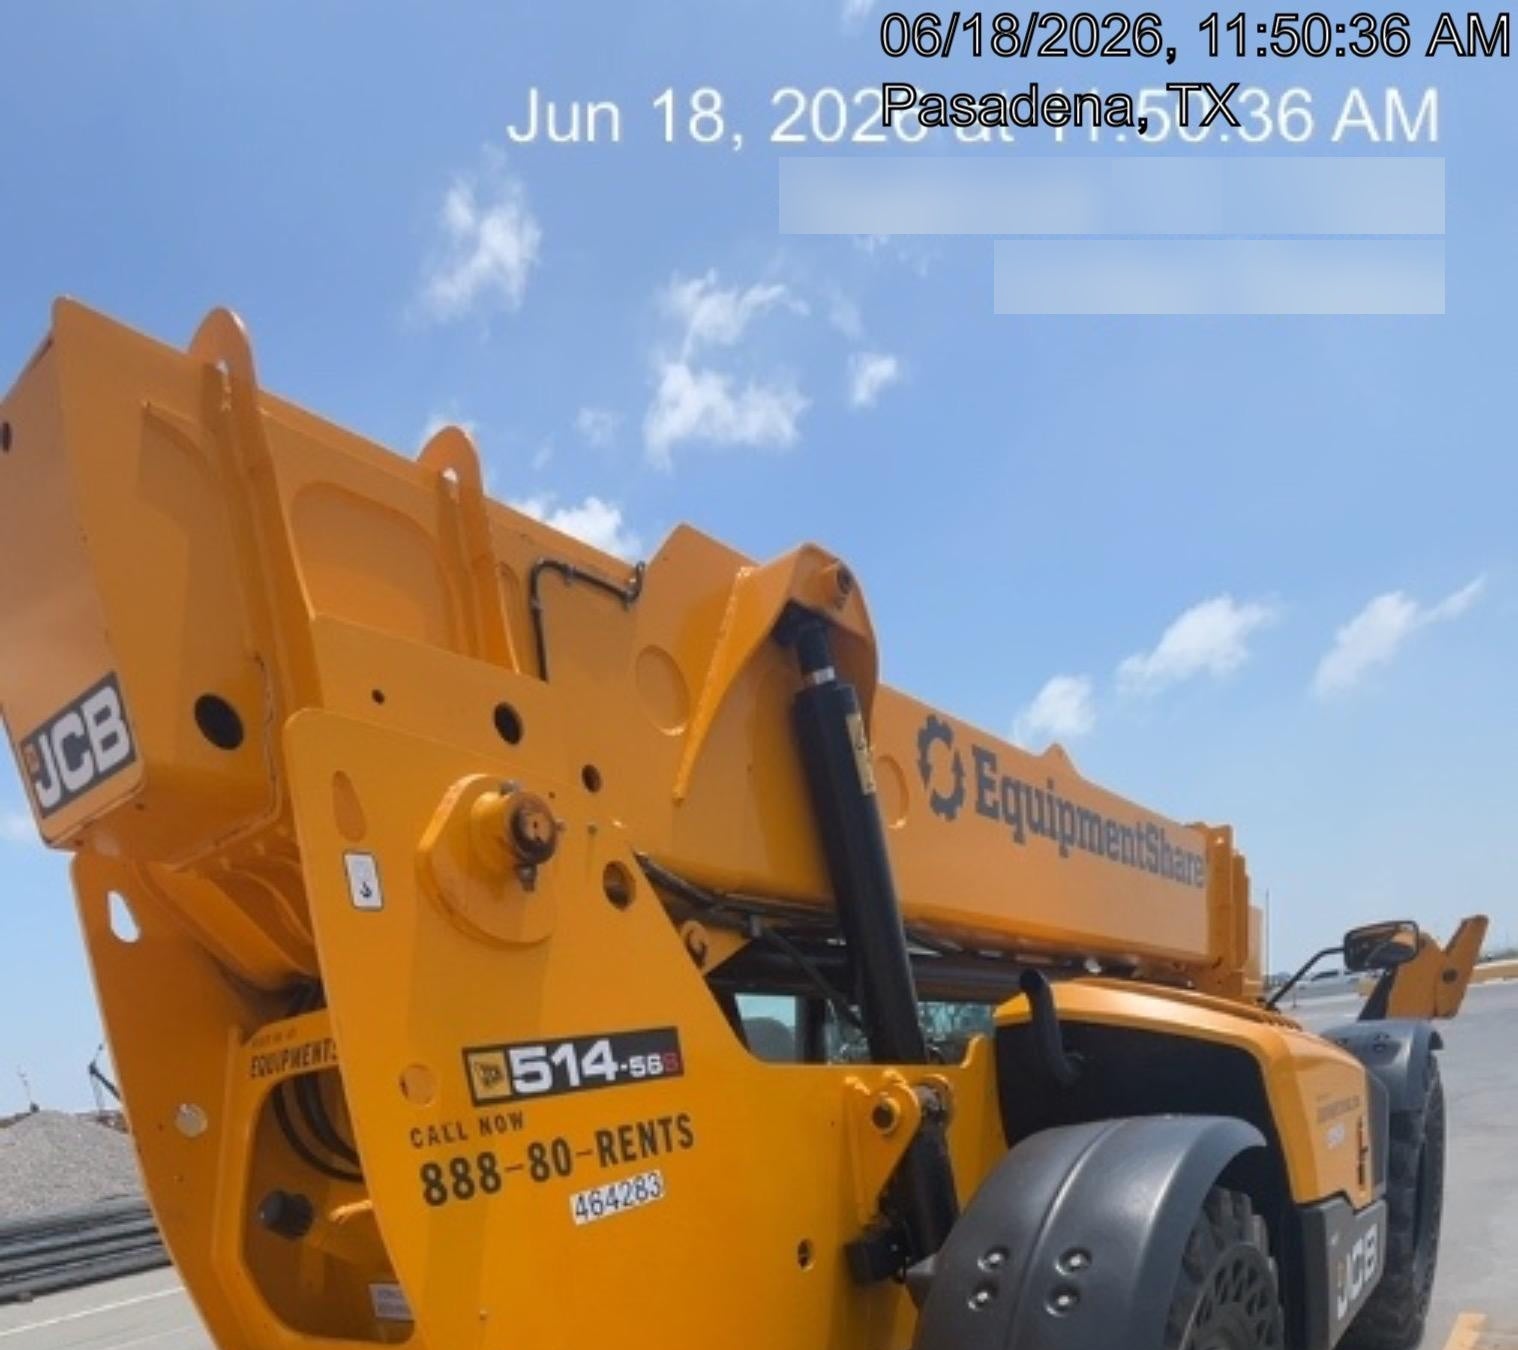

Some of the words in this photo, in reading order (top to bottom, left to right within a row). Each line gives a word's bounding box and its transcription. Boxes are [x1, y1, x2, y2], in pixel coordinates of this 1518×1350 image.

[35, 685, 131, 808] JCB
[972, 744, 1204, 888] EquipmentShare
[409, 1121, 469, 1149] CALL
[479, 1111, 524, 1136] NOW
[420, 1113, 694, 1207] 888-80-RENTS
[575, 1173, 662, 1220] 464283
[1337, 1223, 1377, 1321] JCB
